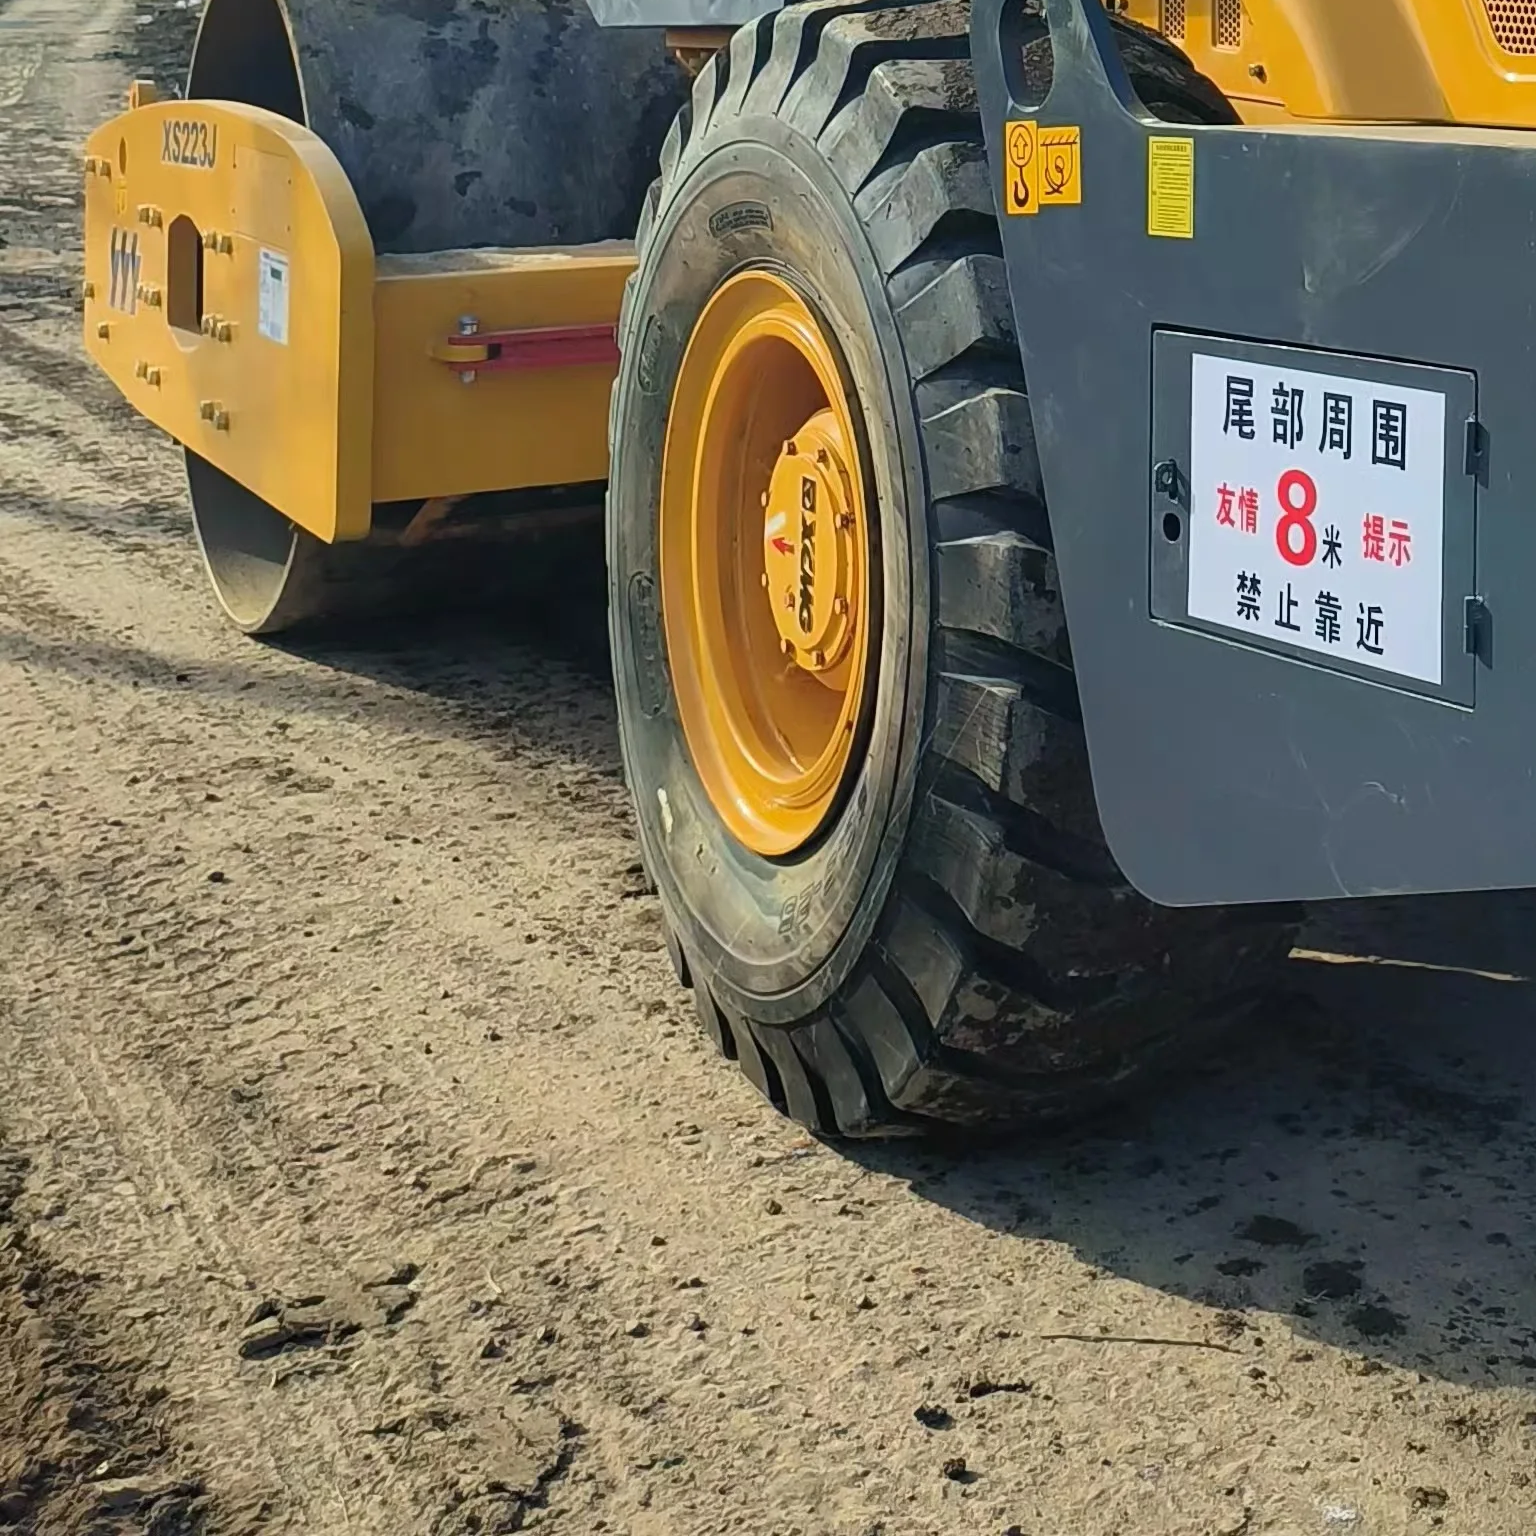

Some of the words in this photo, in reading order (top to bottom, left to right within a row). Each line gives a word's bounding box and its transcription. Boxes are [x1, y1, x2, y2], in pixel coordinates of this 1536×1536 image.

[162, 119, 218, 168] XS223J
[1222, 375, 1407, 471] 尾部周围
[1216, 482, 1259, 534] 友情
[1362, 513, 1412, 567] 提示
[1236, 570, 1385, 656] 禁止靠近
